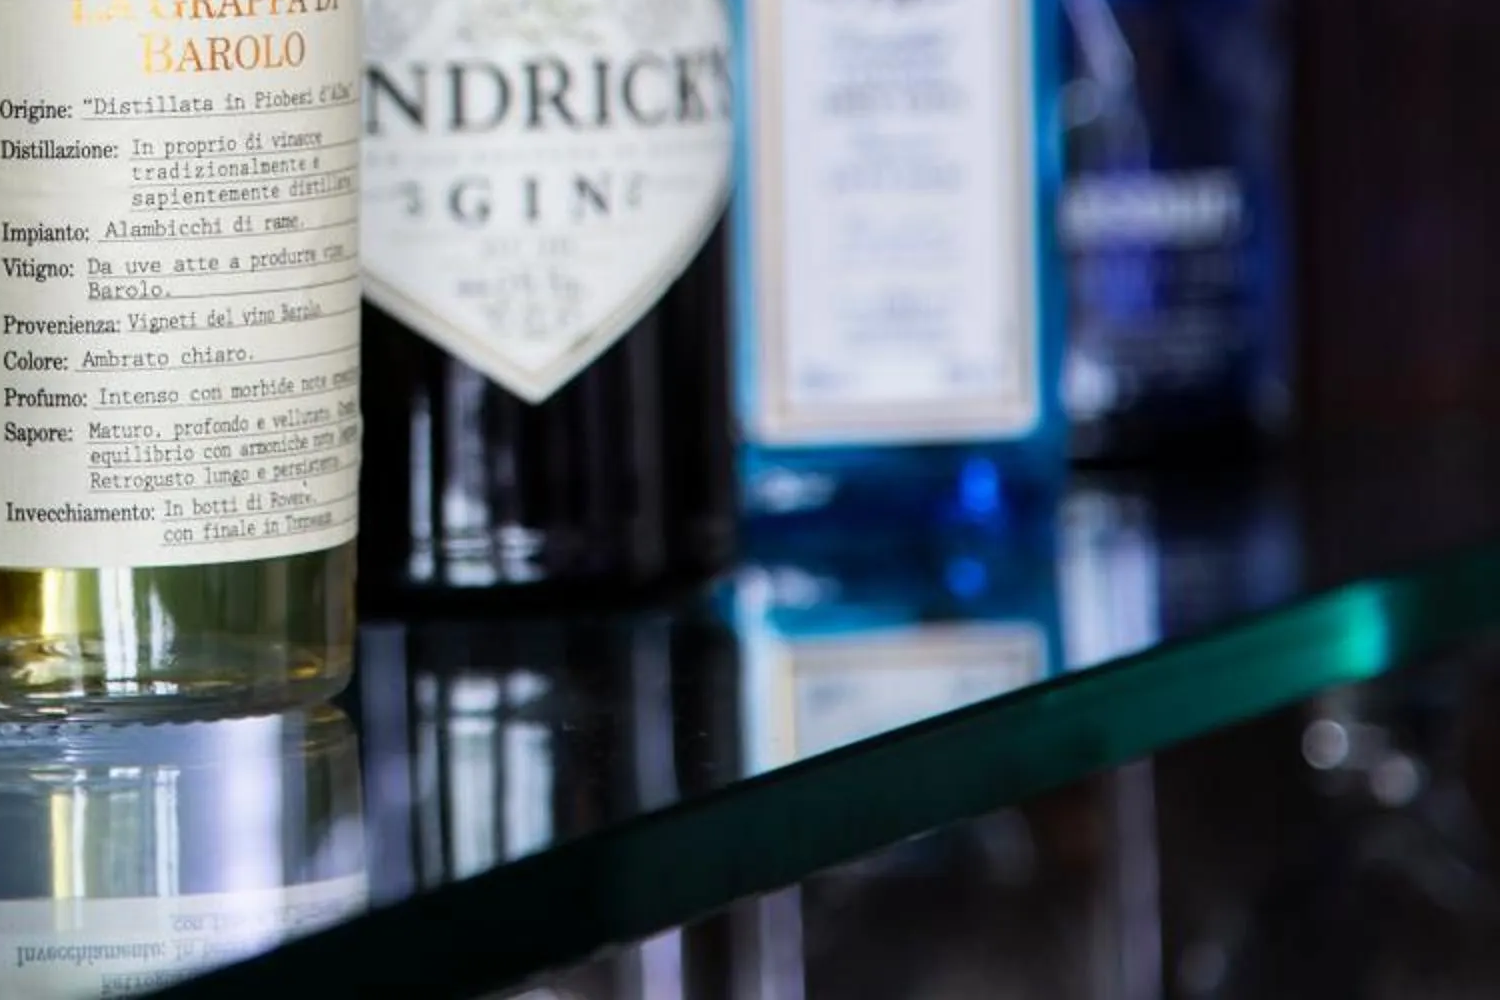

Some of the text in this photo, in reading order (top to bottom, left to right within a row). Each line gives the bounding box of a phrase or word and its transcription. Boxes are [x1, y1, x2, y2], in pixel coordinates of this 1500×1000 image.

[141, 30, 306, 75] BAROLO
[0, 99, 73, 123] Origine:
[225, 92, 245, 110] in
[0, 138, 120, 160] Distillazione:
[132, 139, 155, 155] In
[165, 135, 237, 158] proprio
[245, 132, 263, 150] di
[132, 157, 306, 181] tradizionalmente
[131, 184, 279, 209] sapientemente
[448, 173, 613, 225] GIN
[2, 222, 90, 246] Impianto:
[104, 217, 222, 238] Alambicchi
[233, 215, 253, 233] di
[2, 258, 74, 282] Vitigno:
[88, 258, 112, 276] Da
[125, 258, 162, 275] uve
[174, 254, 220, 273] atte
[229, 256, 240, 269] a
[88, 280, 171, 300] Barolo.
[3, 315, 121, 335] Provenienza:
[128, 312, 197, 334] Vigneti
[207, 308, 234, 327] del
[3, 345, 255, 371] Colore: Ambrato chiaro.
[3, 387, 88, 408] Profumo:
[98, 387, 180, 405] Intenso
[190, 386, 223, 401] con
[231, 377, 295, 399] morbide
[4, 421, 74, 446] Sapore:
[174, 414, 250, 440] profondo
[256, 417, 266, 431] e
[90, 442, 195, 468] equilibrio
[203, 444, 232, 460] con
[90, 468, 195, 489] Retrogusto
[204, 466, 250, 488] lungo
[257, 467, 266, 479] e
[6, 502, 156, 523] Invecchiamento:
[164, 500, 184, 517] In
[193, 494, 238, 515] botti
[247, 491, 263, 511] di
[163, 527, 193, 543] con
[203, 517, 256, 540] finale
[264, 517, 279, 534] in
